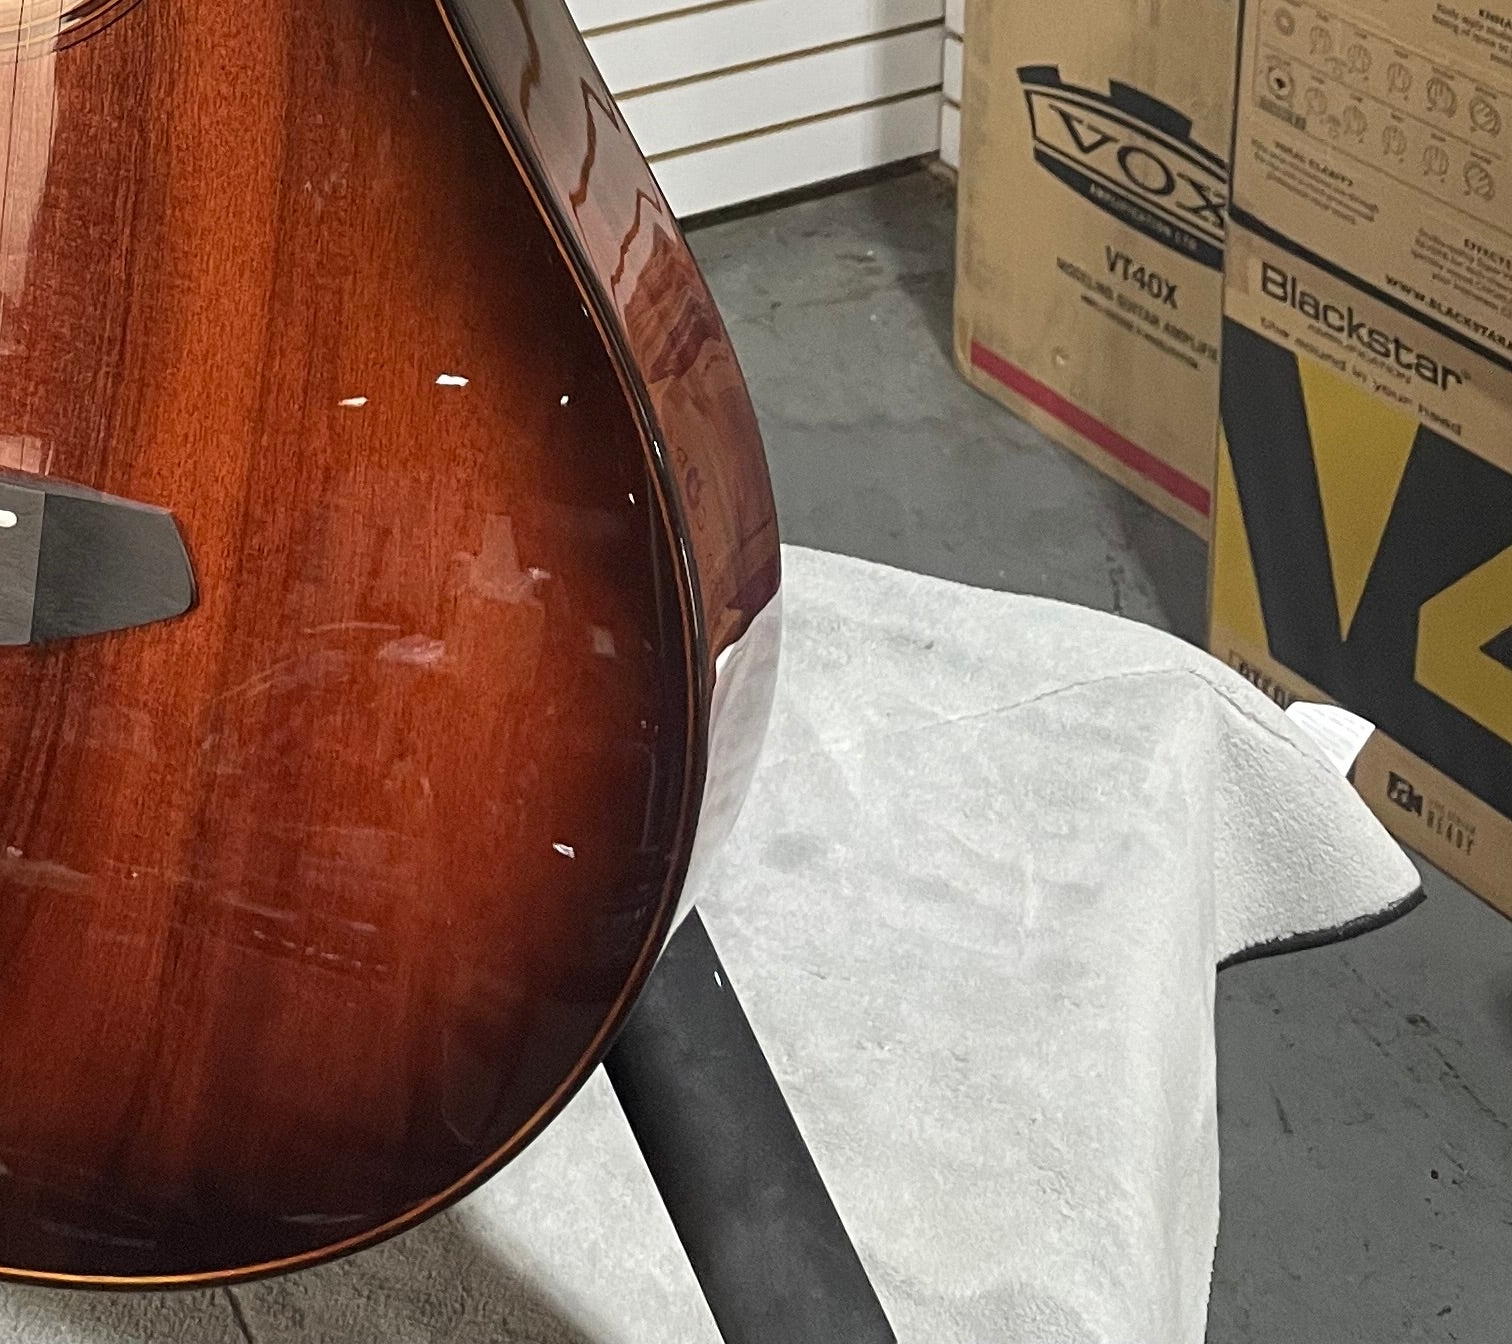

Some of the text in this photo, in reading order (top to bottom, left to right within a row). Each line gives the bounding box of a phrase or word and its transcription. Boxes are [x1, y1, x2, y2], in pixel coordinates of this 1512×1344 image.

[1048, 102, 1225, 230] VOX
[1105, 244, 1178, 310] VT40X
[1261, 260, 1463, 392] Blackstar
